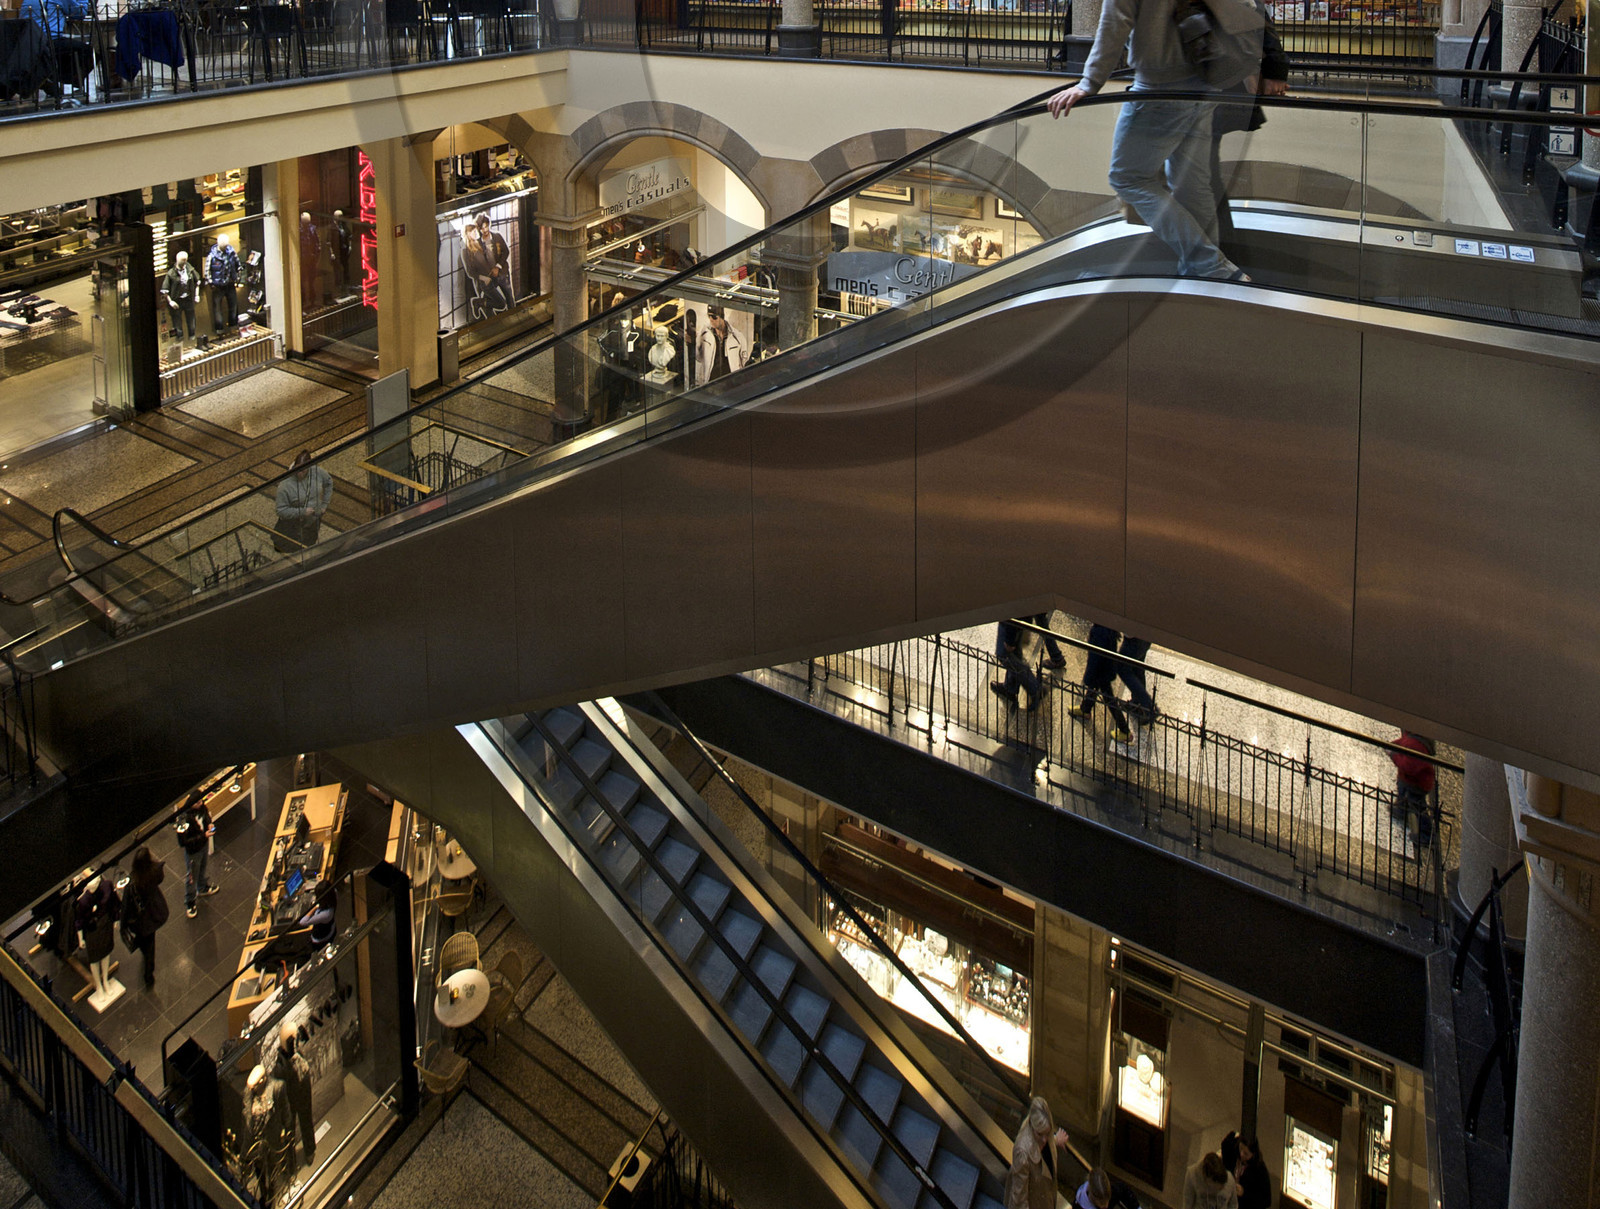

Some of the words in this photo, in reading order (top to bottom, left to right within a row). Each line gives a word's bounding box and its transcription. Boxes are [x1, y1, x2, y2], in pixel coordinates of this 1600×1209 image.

[626, 165, 660, 195] Gentle
[603, 201, 624, 217] men's
[627, 177, 690, 209] casuals
[359, 151, 379, 311] REPLAY
[835, 276, 879, 297] men's
[894, 256, 956, 289] Gentl
